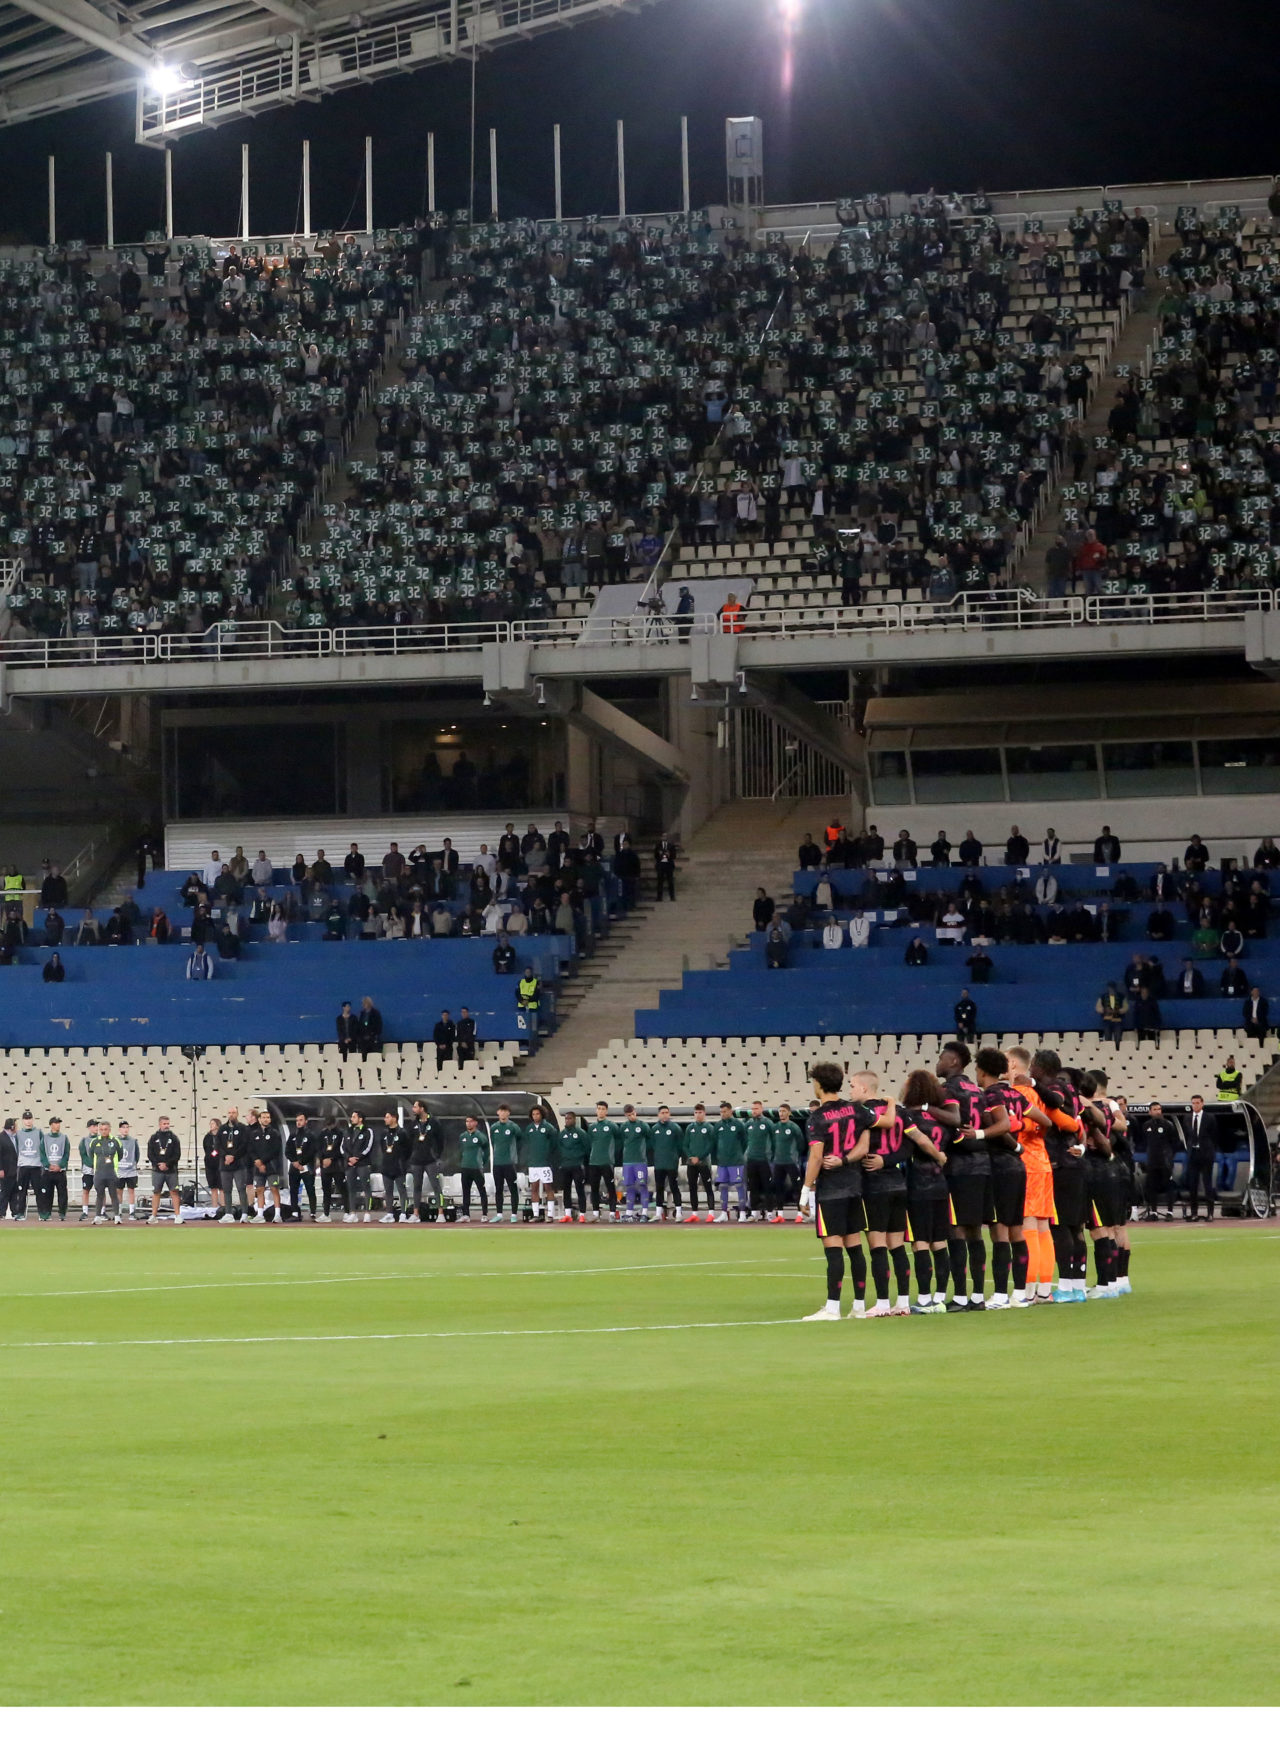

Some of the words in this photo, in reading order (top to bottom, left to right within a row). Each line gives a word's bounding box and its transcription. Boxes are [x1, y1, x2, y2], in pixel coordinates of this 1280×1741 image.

[291, 247, 302, 258] 32
[362, 320, 373, 330] 32
[150, 344, 162, 354] 32
[922, 349, 933, 360] 32
[1179, 349, 1192, 361] 32
[285, 357, 296, 367] 32
[520, 367, 531, 378] 32
[660, 365, 672, 376] 32
[300, 400, 311, 411] 32
[777, 402, 789, 414] 32
[1171, 398, 1183, 409] 32
[462, 422, 474, 433] 32
[886, 416, 898, 428] 32
[544, 440, 556, 451] 32
[1009, 444, 1020, 456] 32
[701, 480, 713, 492] 32
[138, 492, 151, 503] 32
[194, 503, 206, 514] 32
[324, 504, 336, 516] 32
[949, 501, 962, 513] 32
[542, 510, 554, 522] 32
[1065, 508, 1078, 521] 32
[1242, 512, 1254, 524] 32
[949, 527, 962, 539] 32
[1127, 543, 1140, 555] 32
[155, 559, 168, 572] 32
[30, 588, 42, 599] 32
[407, 586, 420, 598] 32
[1106, 581, 1119, 594] 32
[339, 594, 351, 606] 32
[77, 612, 90, 625] 32
[309, 614, 321, 625] 32
[970, 1096, 981, 1130] 5
[1126, 1106, 1150, 1114] LEAGU
[828, 1119, 856, 1158] 14
